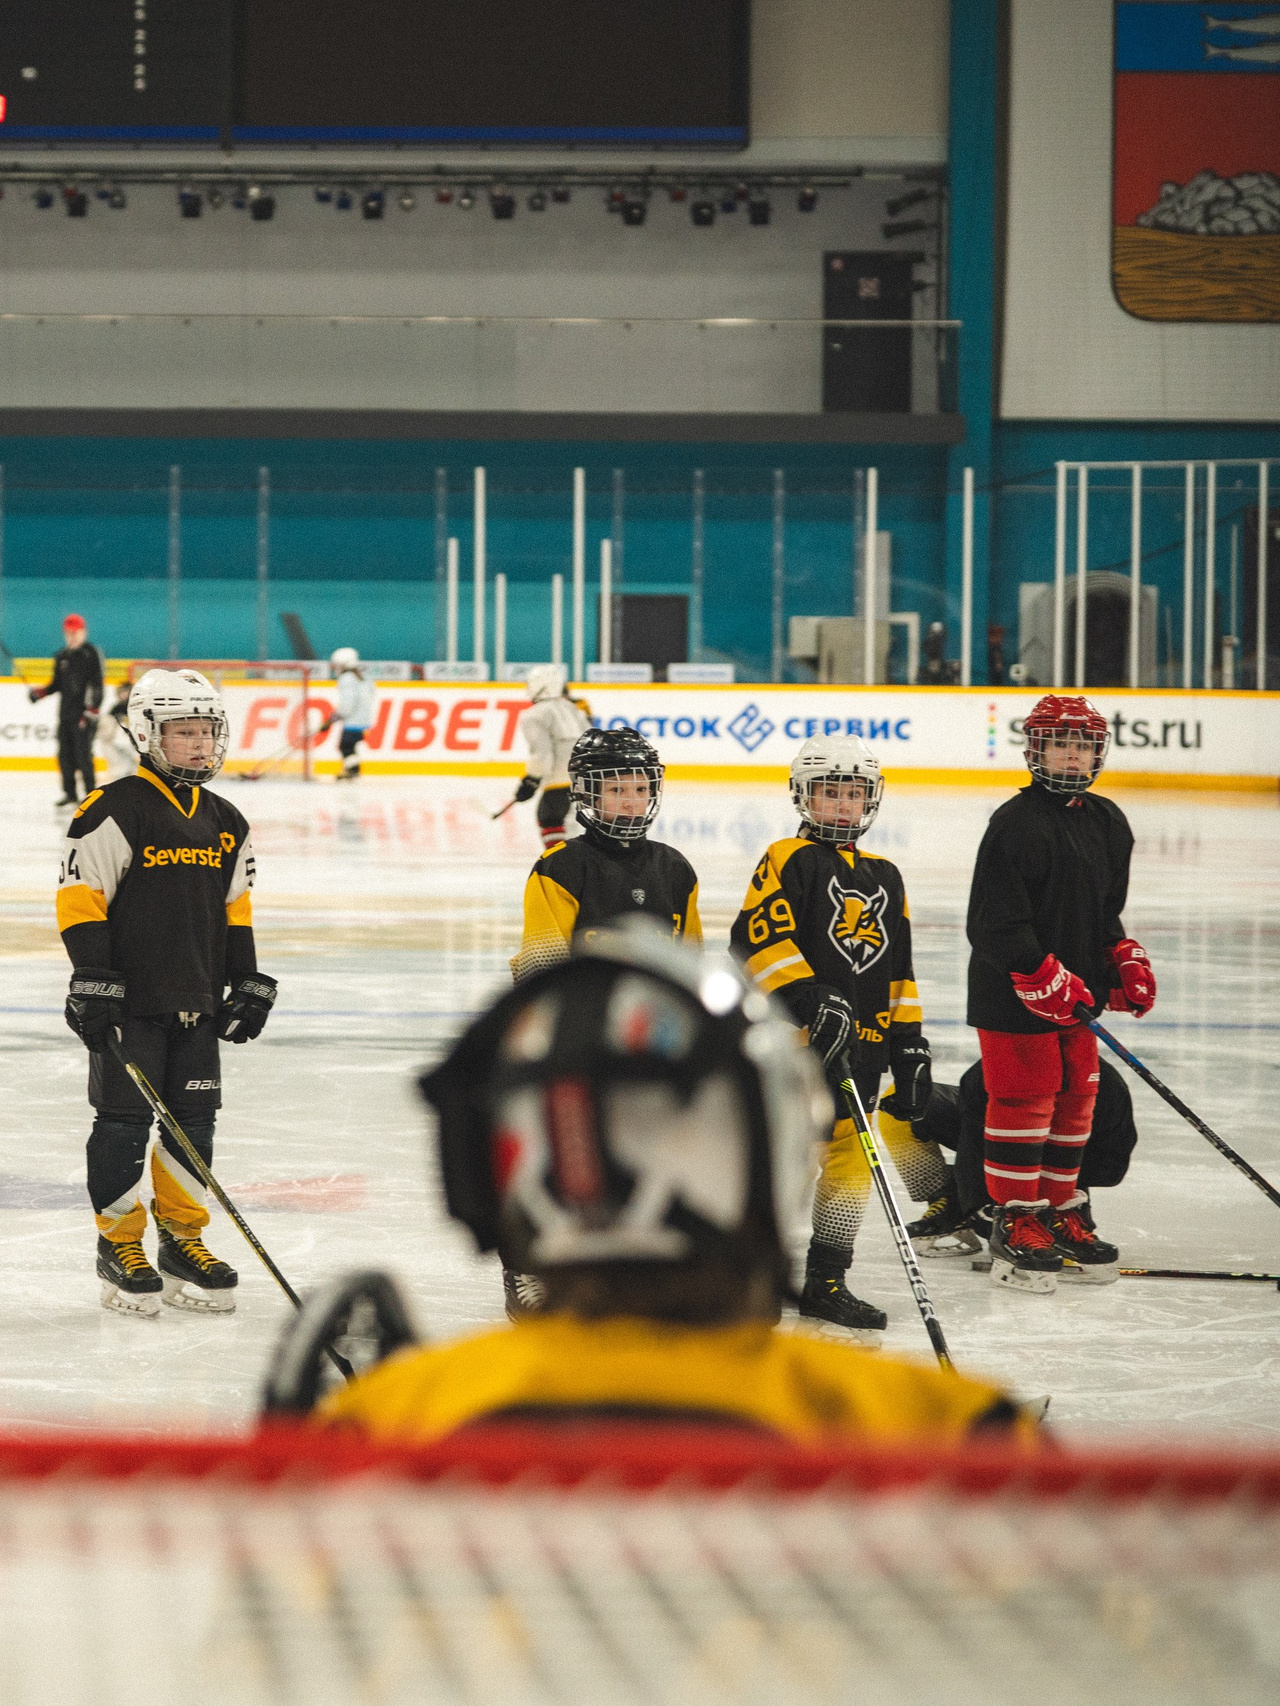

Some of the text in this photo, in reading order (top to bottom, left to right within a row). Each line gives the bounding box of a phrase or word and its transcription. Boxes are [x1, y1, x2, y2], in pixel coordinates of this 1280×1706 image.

[784, 716, 911, 740] СЕРВИС
[1009, 711, 1202, 749] sts.ru
[748, 898, 797, 945] 69
